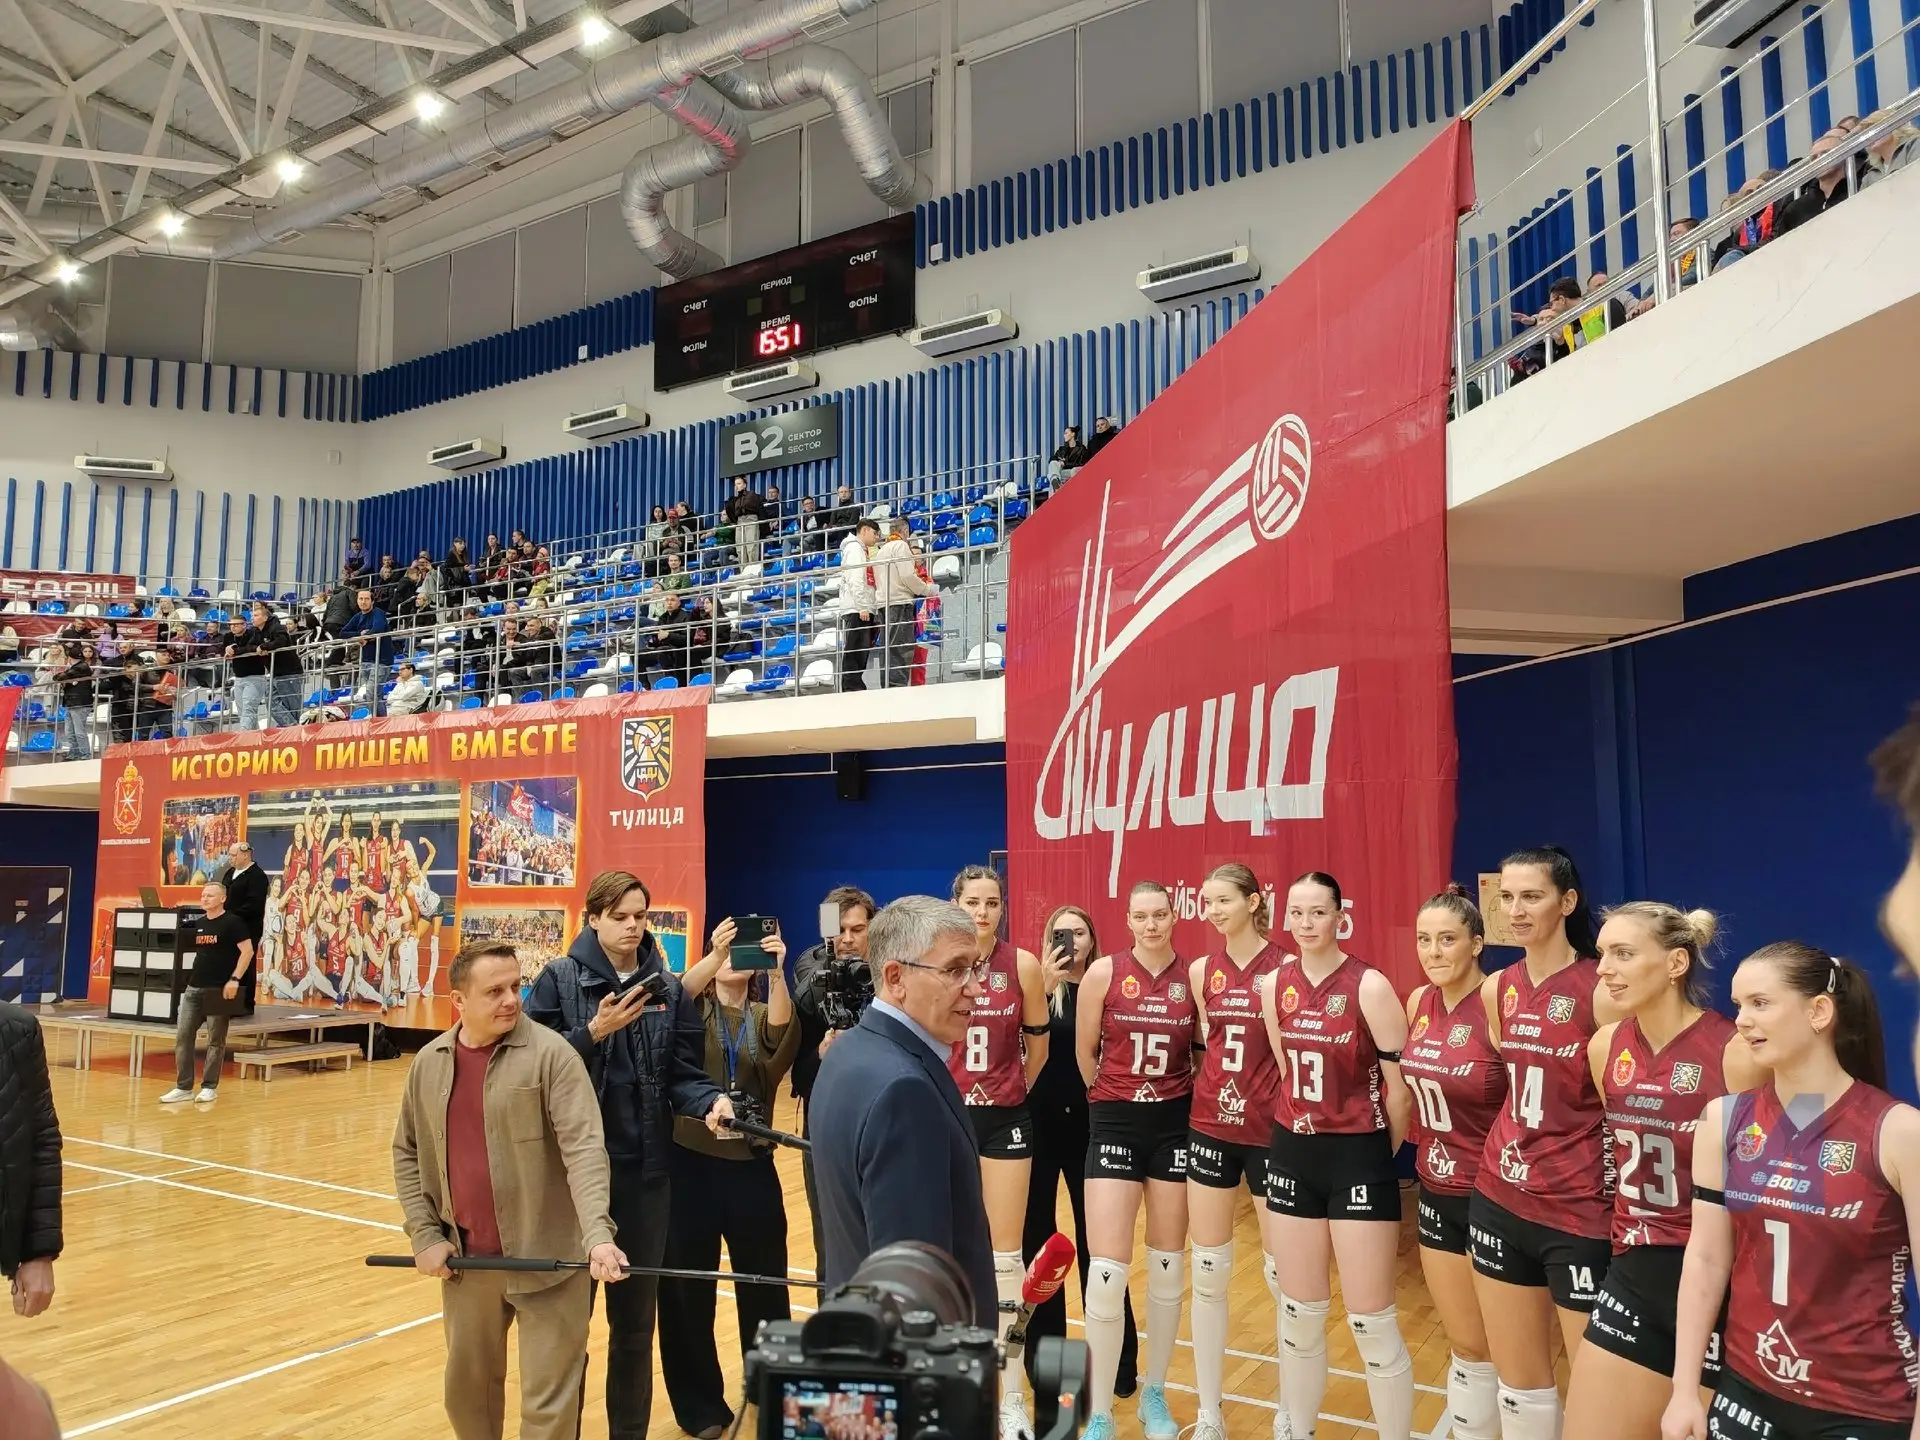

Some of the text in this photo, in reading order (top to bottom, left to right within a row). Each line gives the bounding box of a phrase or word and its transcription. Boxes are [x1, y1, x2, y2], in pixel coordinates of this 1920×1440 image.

[760, 276, 792, 292] ПЕРИОД
[848, 294, 878, 309] ФОЛЫ
[760, 315, 791, 329] ВРЕМЯ
[682, 340, 708, 353] ФОЛЫ
[787, 428, 822, 442] СЕКТОР
[733, 425, 784, 465] B2
[787, 440, 822, 454] SECTOR
[171, 722, 577, 781] ИСТОРИЮ ПИШЕМ ВМЕСТЕ
[975, 996, 990, 1005] ФВ
[1146, 1004, 1167, 1013] ВФВ
[1114, 1014, 1177, 1025] ТЕХНОДИНАМИКА
[1301, 1019, 1323, 1029] ВФВ
[1517, 1024, 1542, 1038] ВФВ
[965, 1026, 989, 1072] 8
[1130, 1032, 1170, 1076] 15
[1221, 1024, 1245, 1072] 5
[1419, 1048, 1441, 1059] ВФВ
[1287, 1048, 1324, 1103] 13
[1404, 1074, 1453, 1133] 10
[1507, 1062, 1544, 1129] 14
[1634, 1096, 1663, 1111] ВФВ
[1173, 1149, 1187, 1167] 15
[1768, 1160, 1808, 1171] ENSEN
[1614, 1128, 1679, 1208] 23
[1766, 1174, 1811, 1193] ВФВ
[1351, 1184, 1367, 1204] 13
[1725, 1189, 1826, 1216] ЕХНОДИНАМИКА
[1763, 1217, 1790, 1306] 1
[1569, 1265, 1594, 1292] 14
